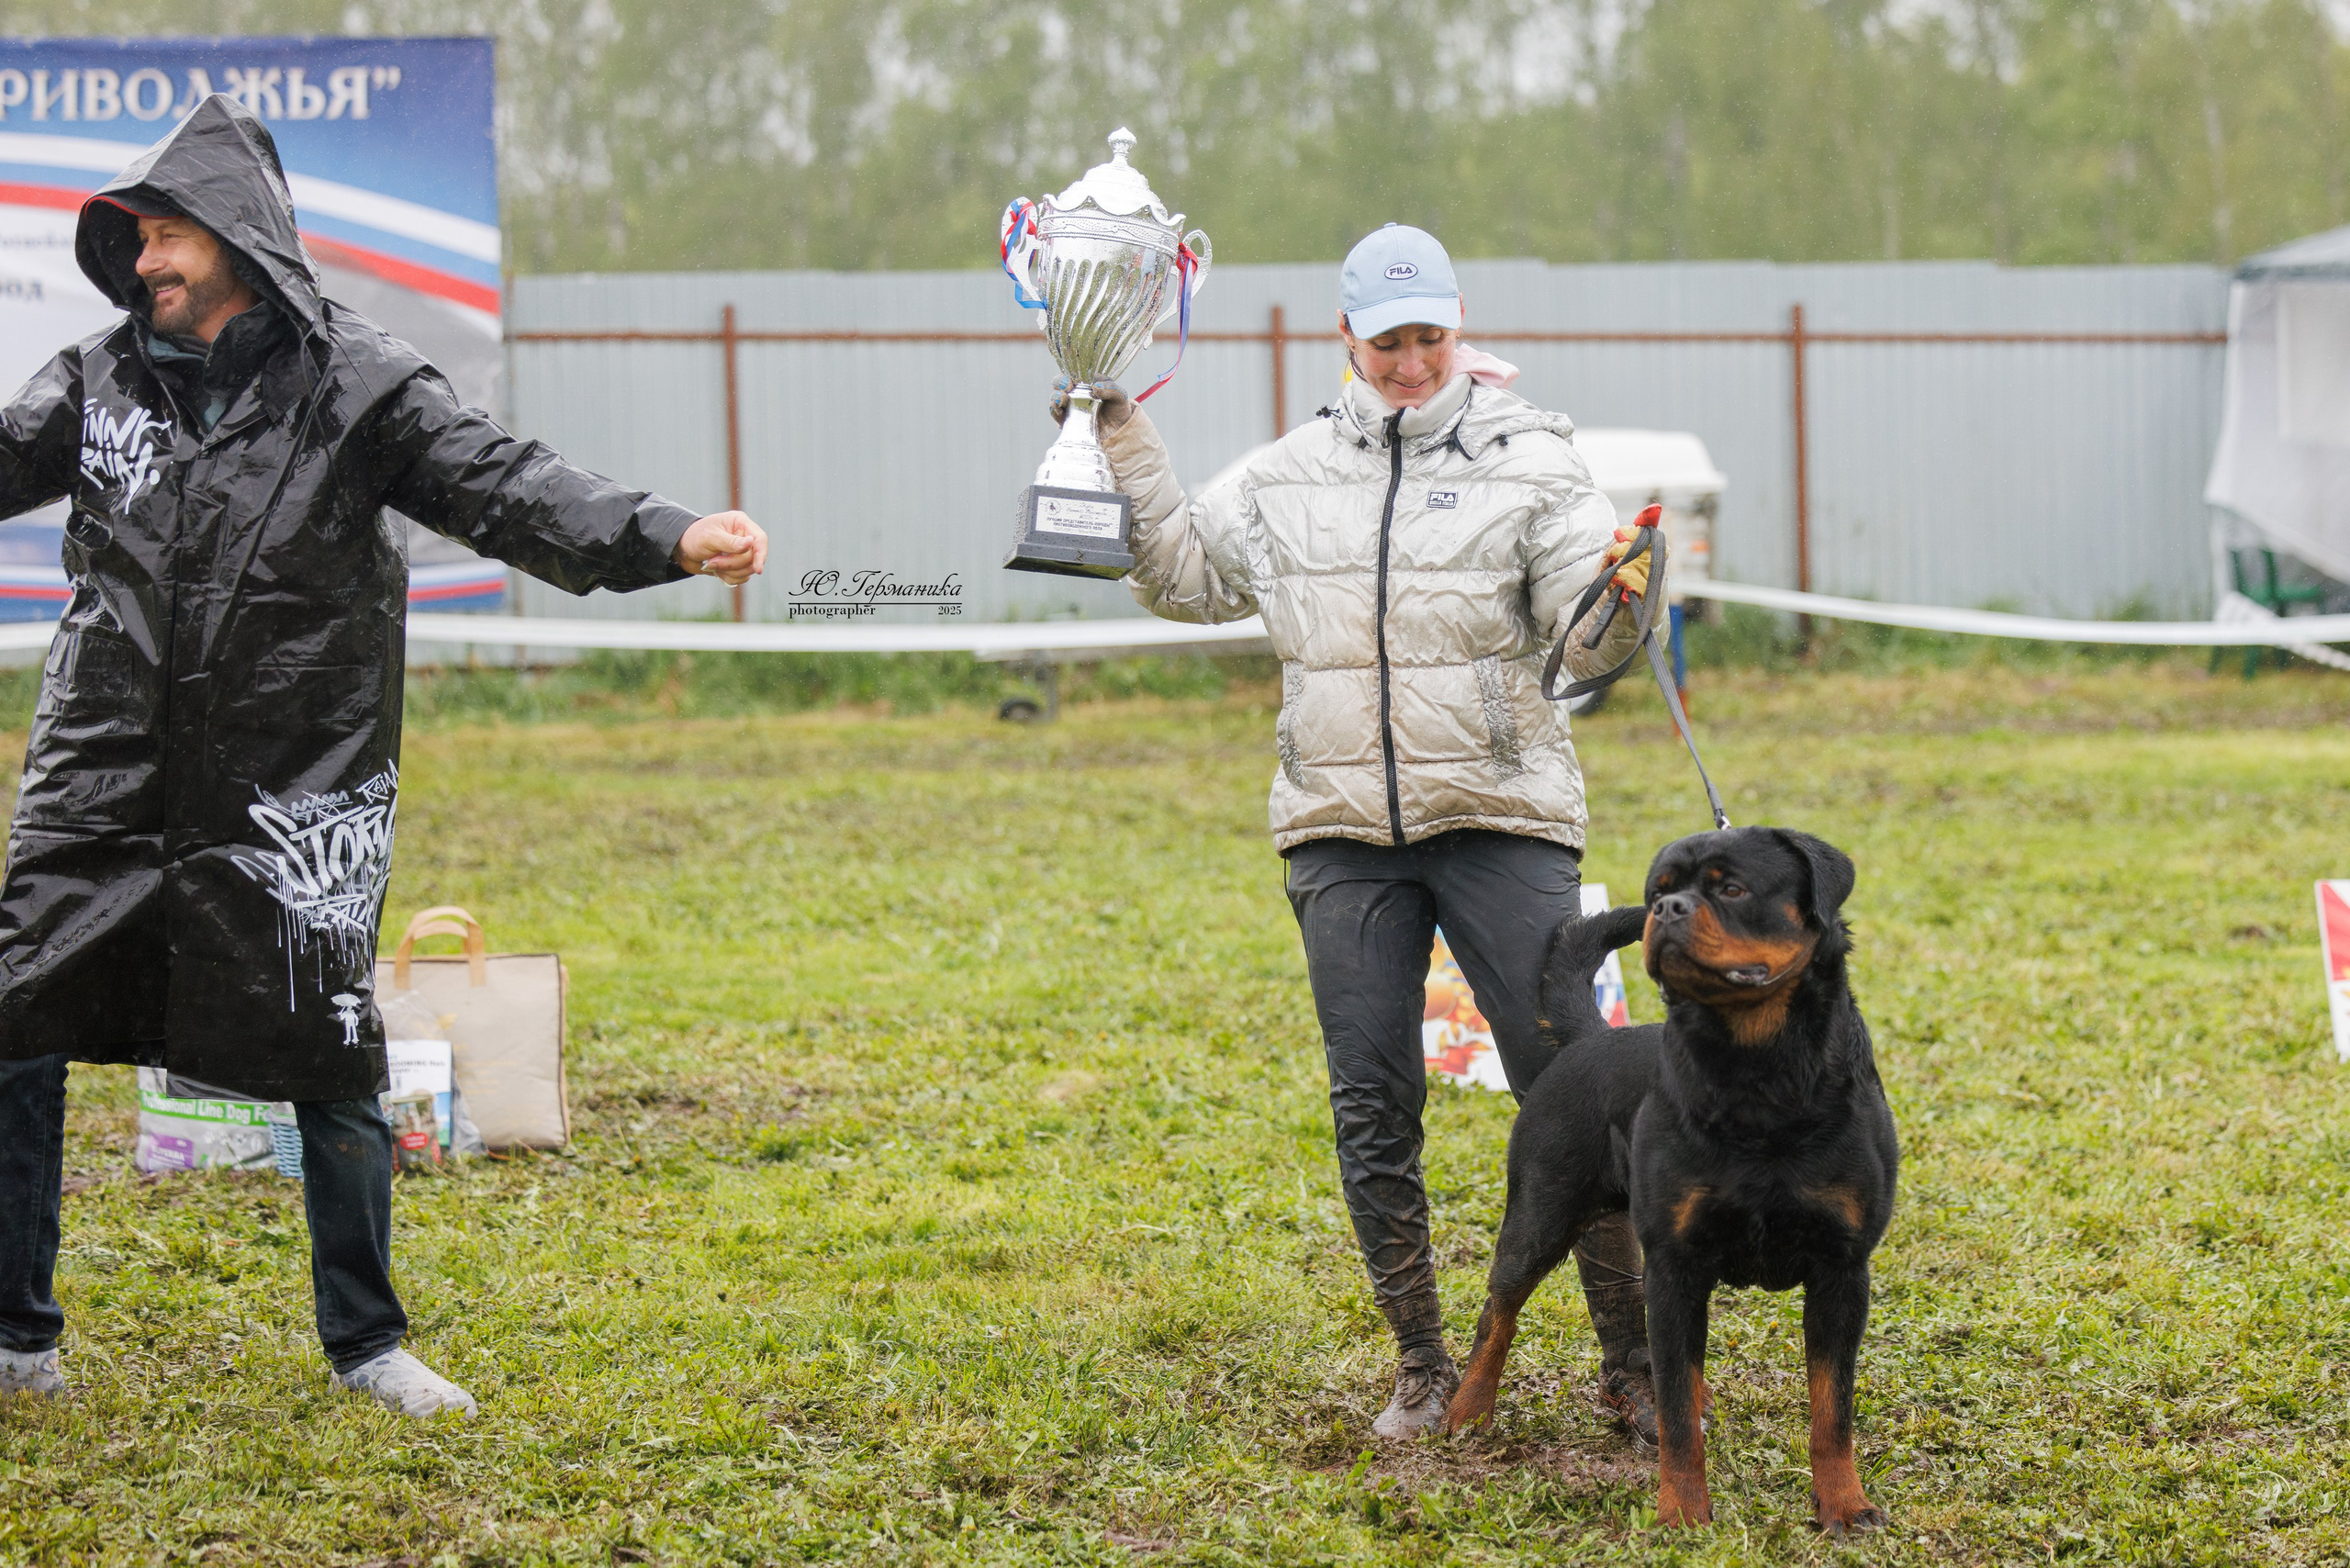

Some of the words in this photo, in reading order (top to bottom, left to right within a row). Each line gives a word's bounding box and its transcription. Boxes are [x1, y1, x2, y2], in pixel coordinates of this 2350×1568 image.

[1389, 266, 1413, 276] FILA
[1430, 493, 1454, 501] FILA
[197, 1101, 225, 1119] Line
[226, 1104, 252, 1126] Dog
